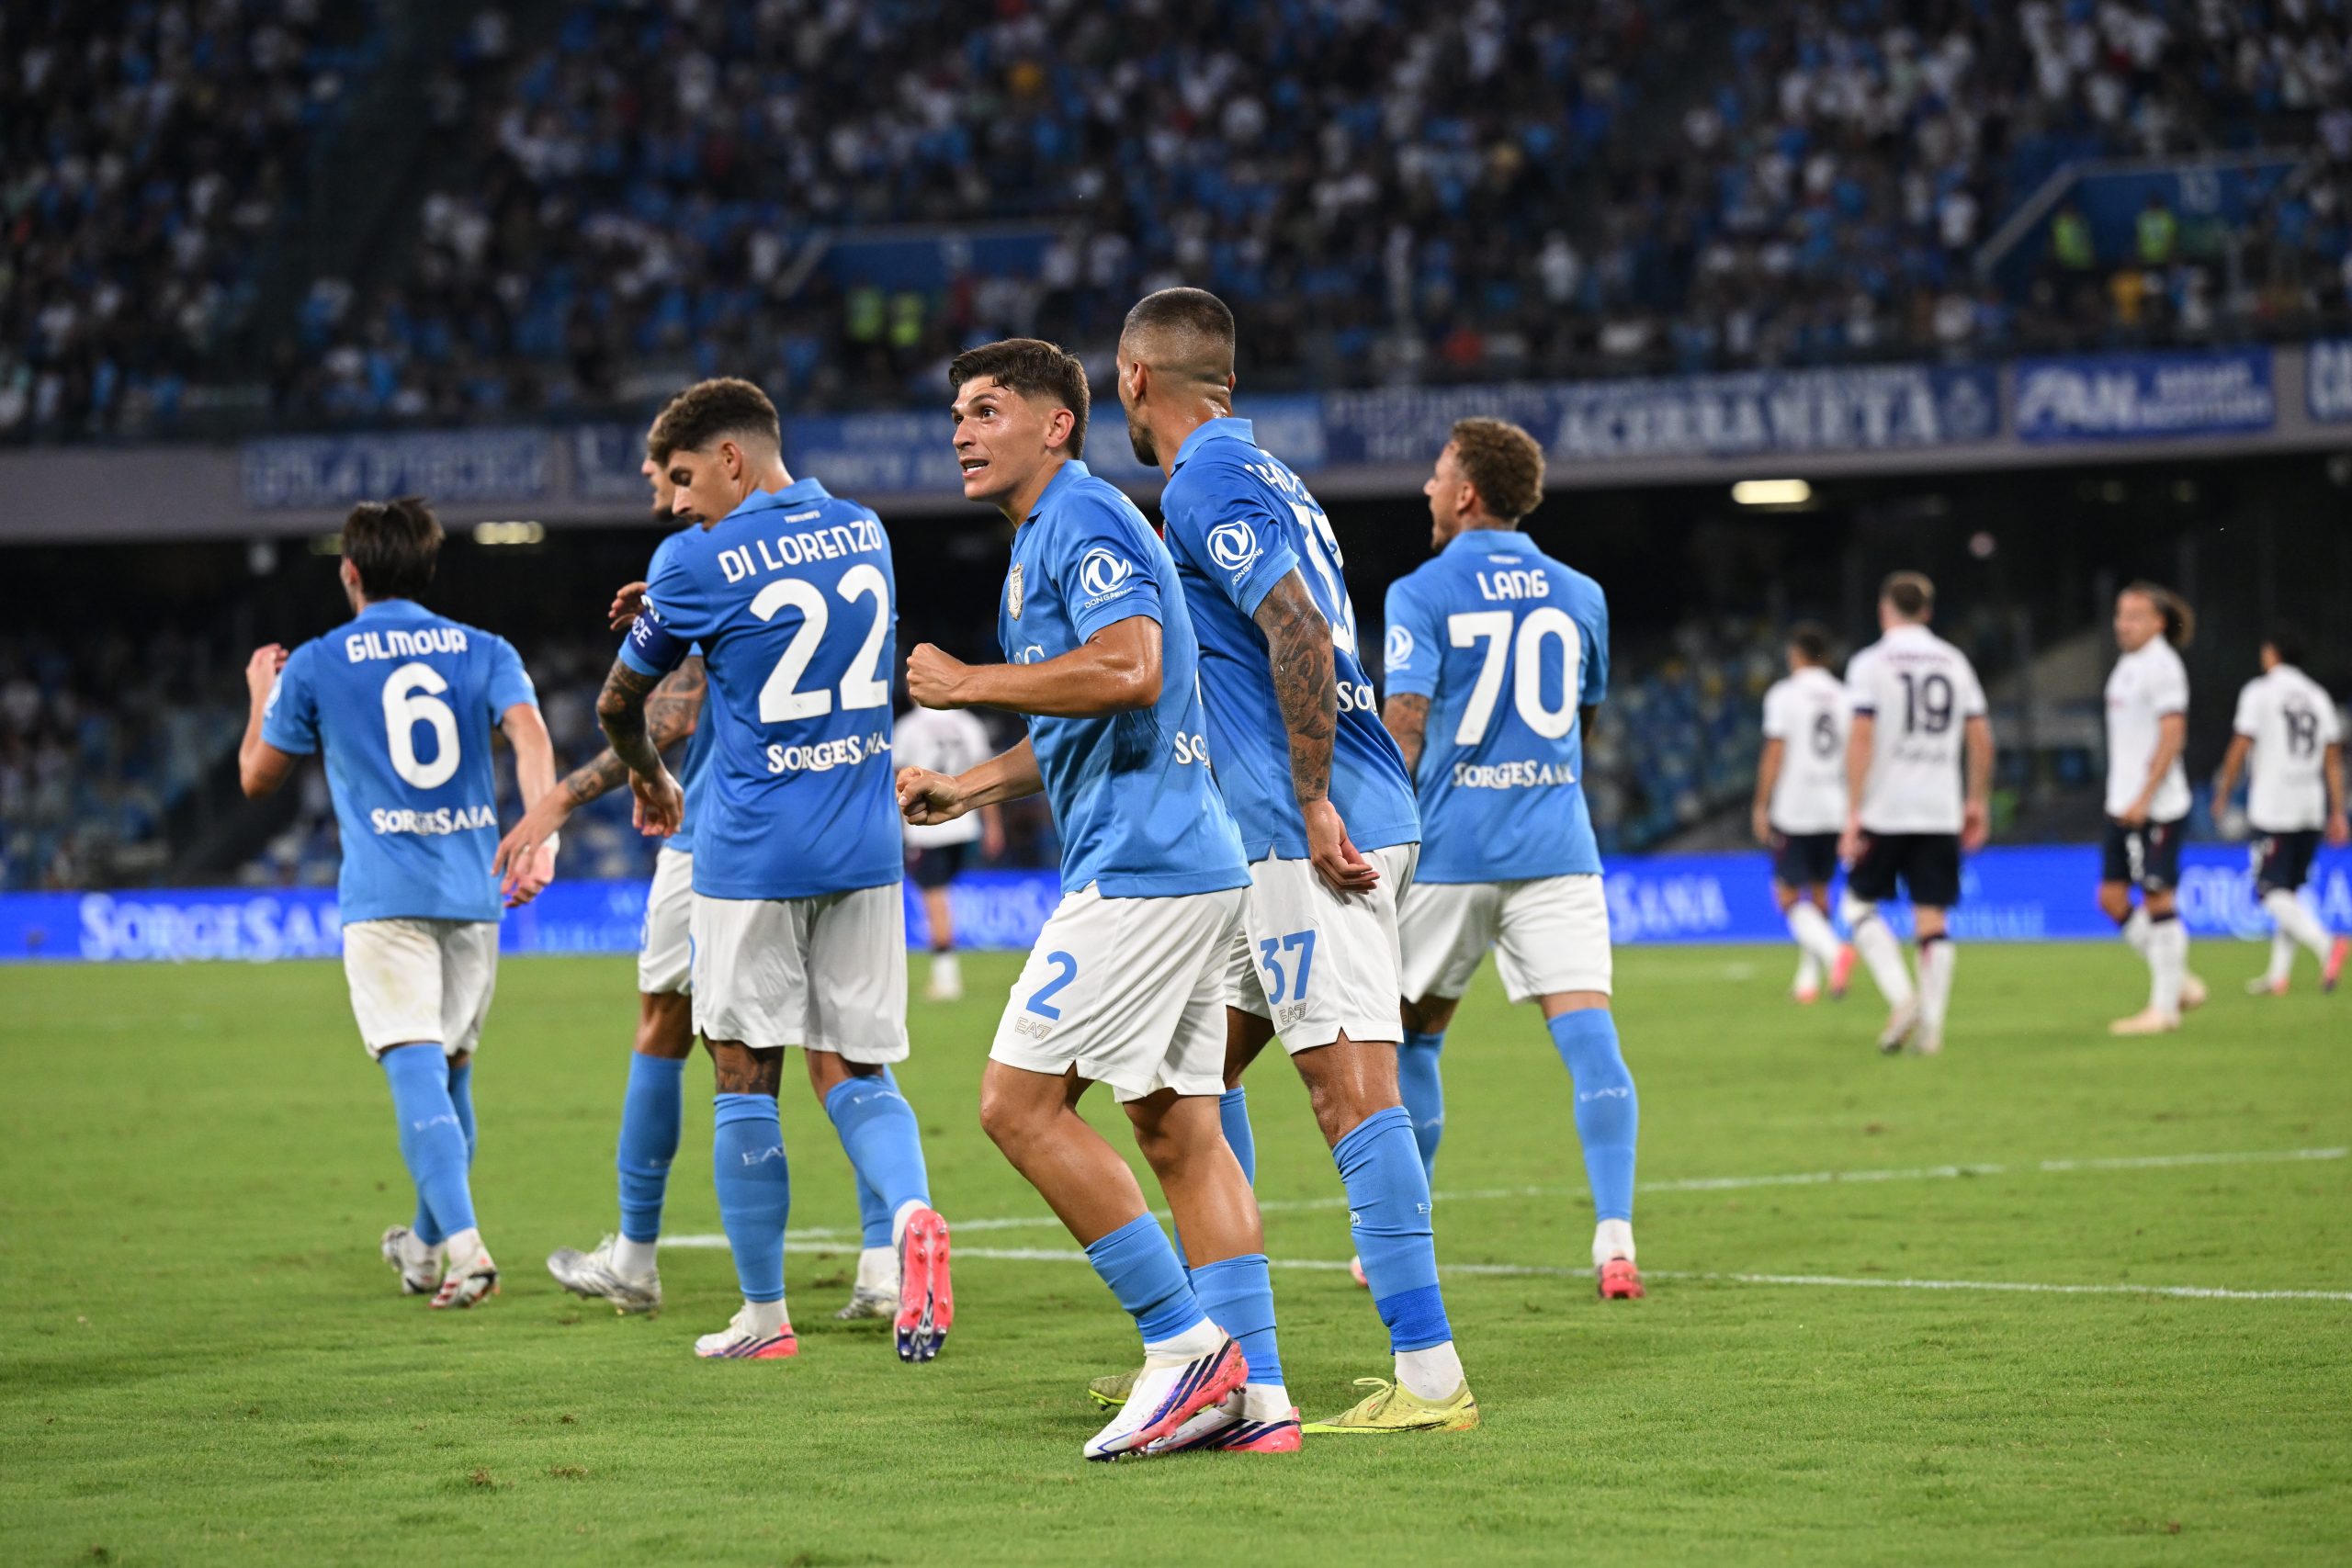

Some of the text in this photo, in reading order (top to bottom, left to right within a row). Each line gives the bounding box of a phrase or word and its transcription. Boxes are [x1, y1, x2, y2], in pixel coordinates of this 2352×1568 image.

[718, 520, 882, 583] DI LORENZO
[1476, 569, 1550, 600] LANG
[345, 627, 469, 663] GILMOUR
[749, 563, 888, 724] 22
[1447, 607, 1581, 745] 70
[1898, 671, 1953, 734] 19
[382, 662, 461, 789] 6
[1025, 951, 1078, 1021] 2
[1260, 929, 1317, 1005] 37
[1014, 1017, 1052, 1041] EA7
[1279, 1002, 1307, 1025] EA7
[741, 1144, 786, 1167] EA
